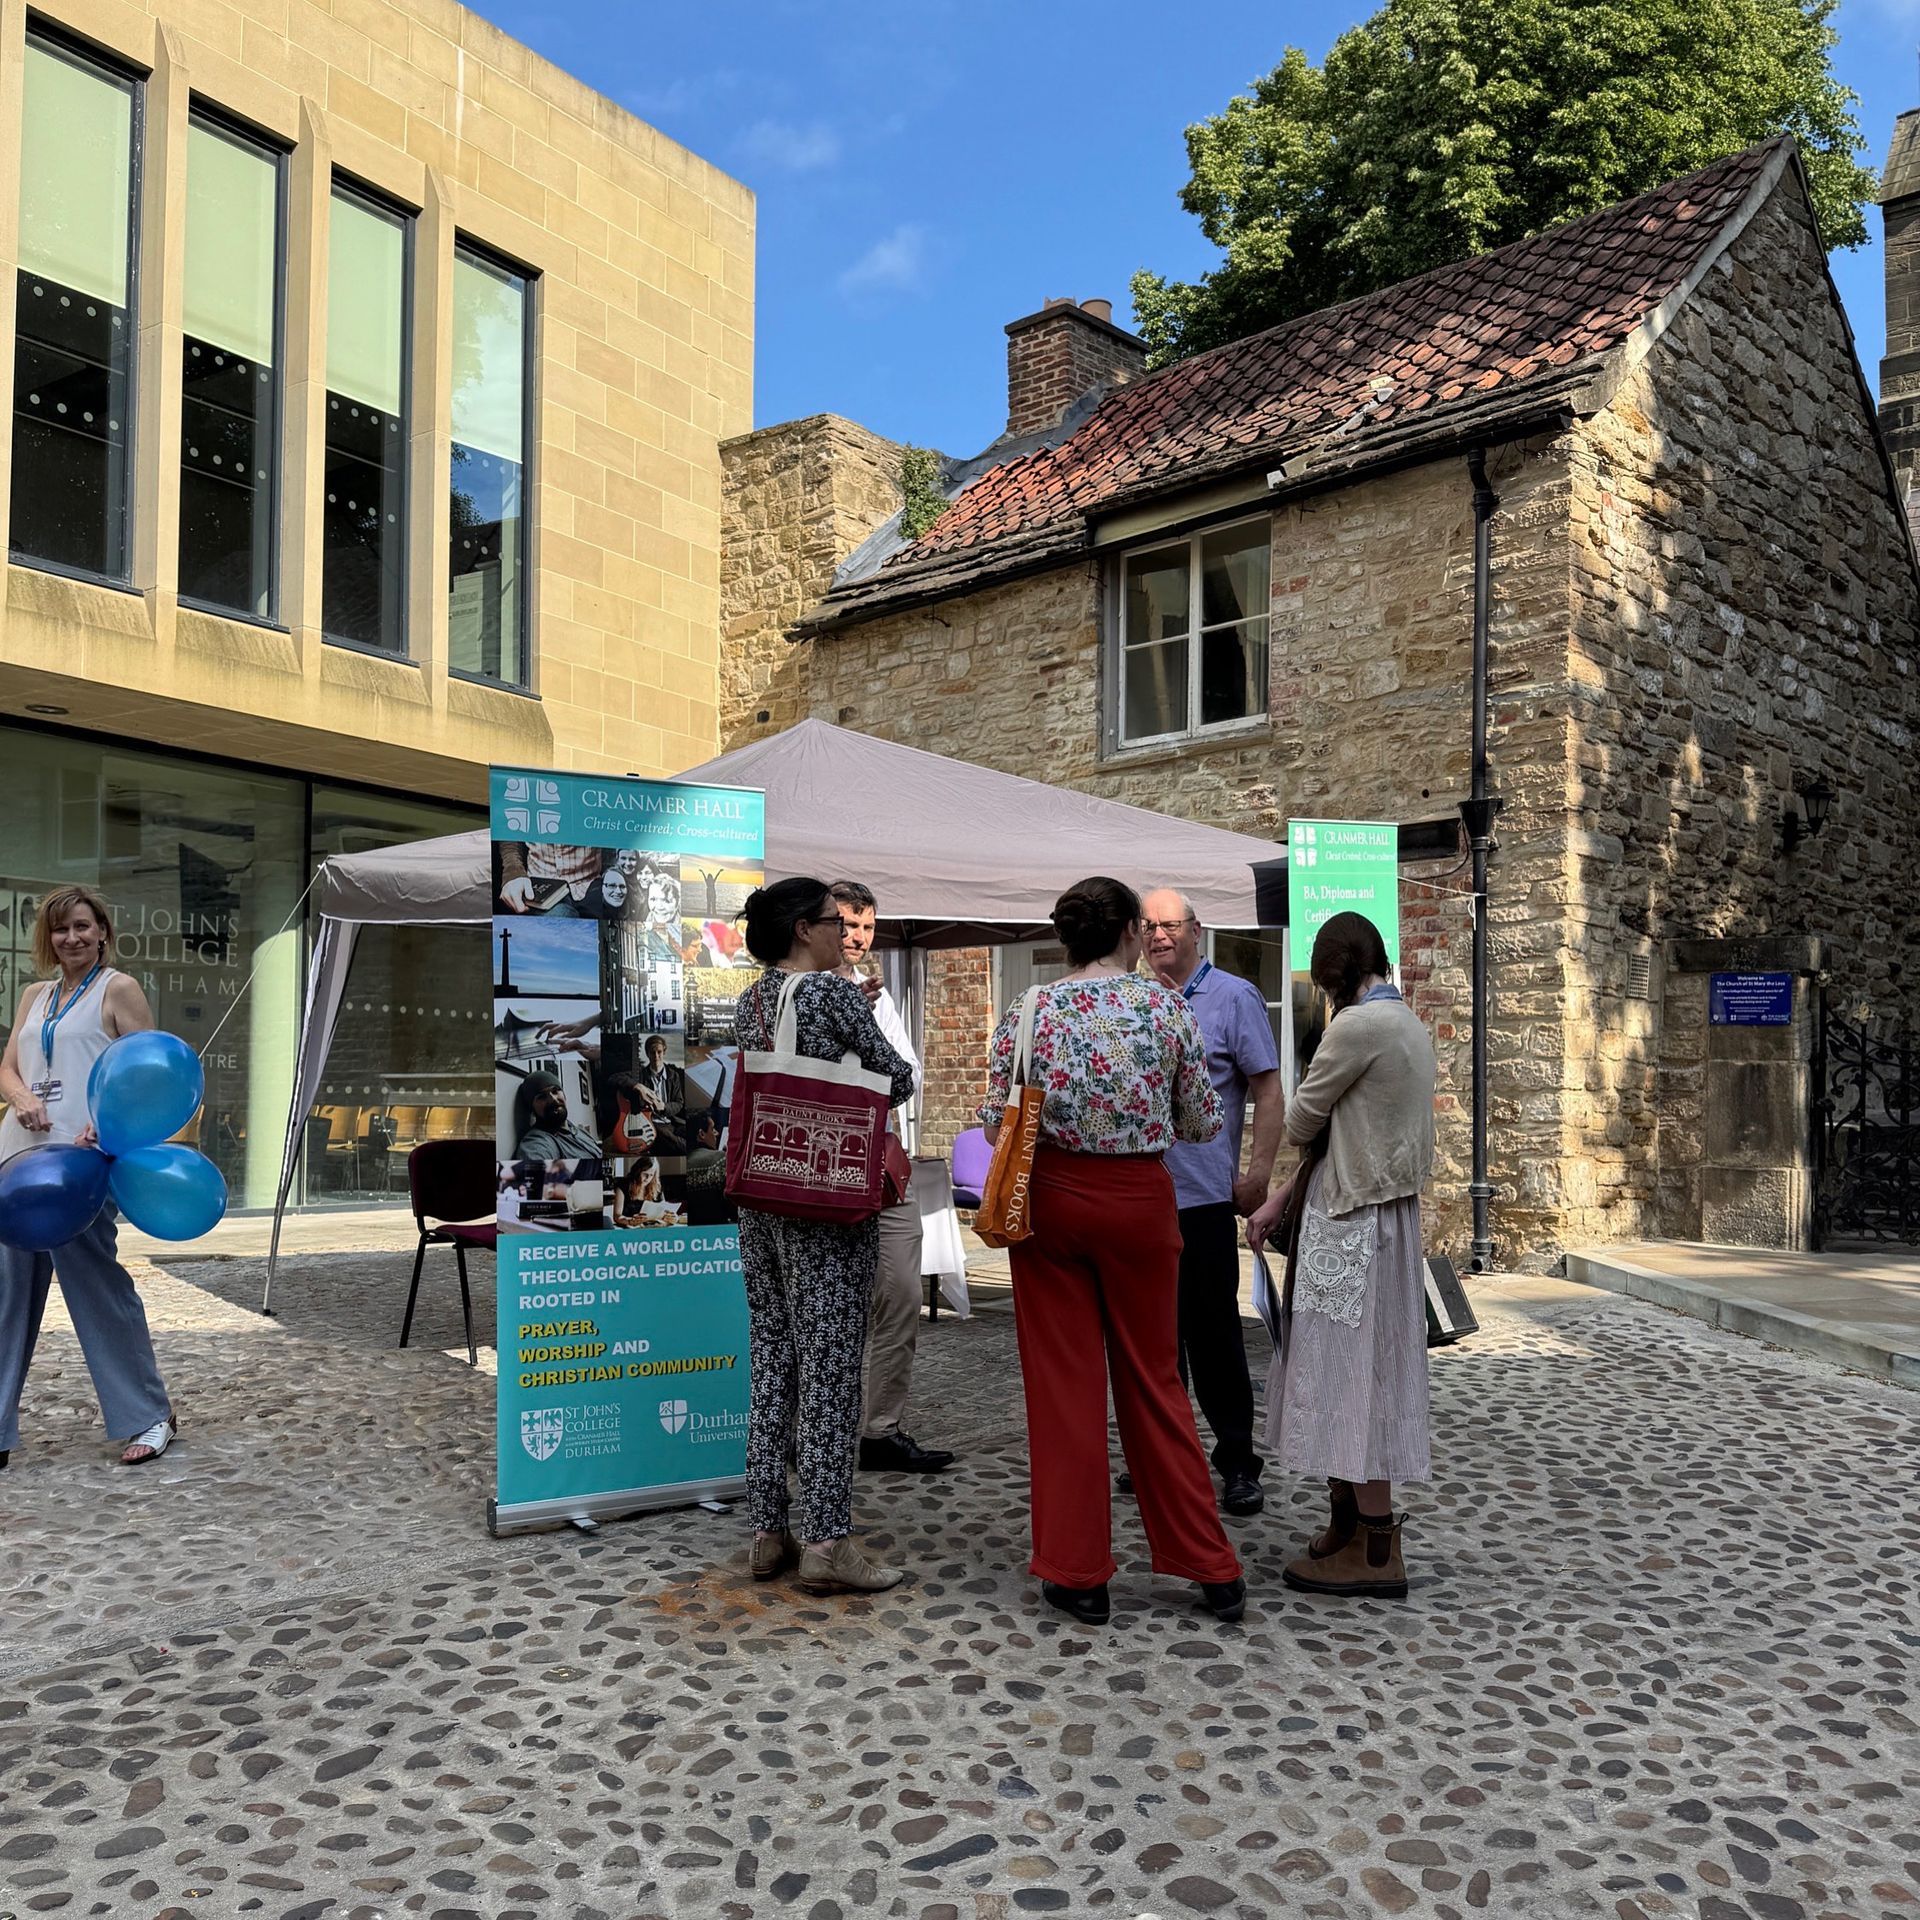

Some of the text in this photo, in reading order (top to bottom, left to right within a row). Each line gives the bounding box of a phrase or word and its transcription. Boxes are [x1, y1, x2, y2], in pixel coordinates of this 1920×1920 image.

[581, 789, 745, 820] CRANMER HALL
[584, 816, 758, 842] Christ Centred; Cross-cultured
[1303, 884, 1375, 904] BA, Diploma and
[106, 903, 240, 939] T JOHN'S
[115, 932, 239, 968] OLLEGE
[142, 971, 237, 996] RHAM
[203, 1053, 238, 1069] TRE
[1004, 1101, 1040, 1233] DAUNT BOOKS
[519, 1243, 599, 1262] RECEIVE
[604, 1243, 618, 1257] A
[622, 1239, 686, 1256] WORLD
[519, 1260, 745, 1285] THEOLOGICAL EDUCATIO
[519, 1289, 620, 1310] ROOTED IN
[518, 1319, 600, 1339] PRAYER,
[518, 1339, 650, 1363] WORSHIP AND
[518, 1354, 737, 1388] CHRISTIAN COMMUNITY
[565, 1402, 621, 1420] ST JOHN'S
[565, 1417, 621, 1433] COLLEGE
[690, 1427, 748, 1444] University
[565, 1444, 621, 1459] DURHAM
